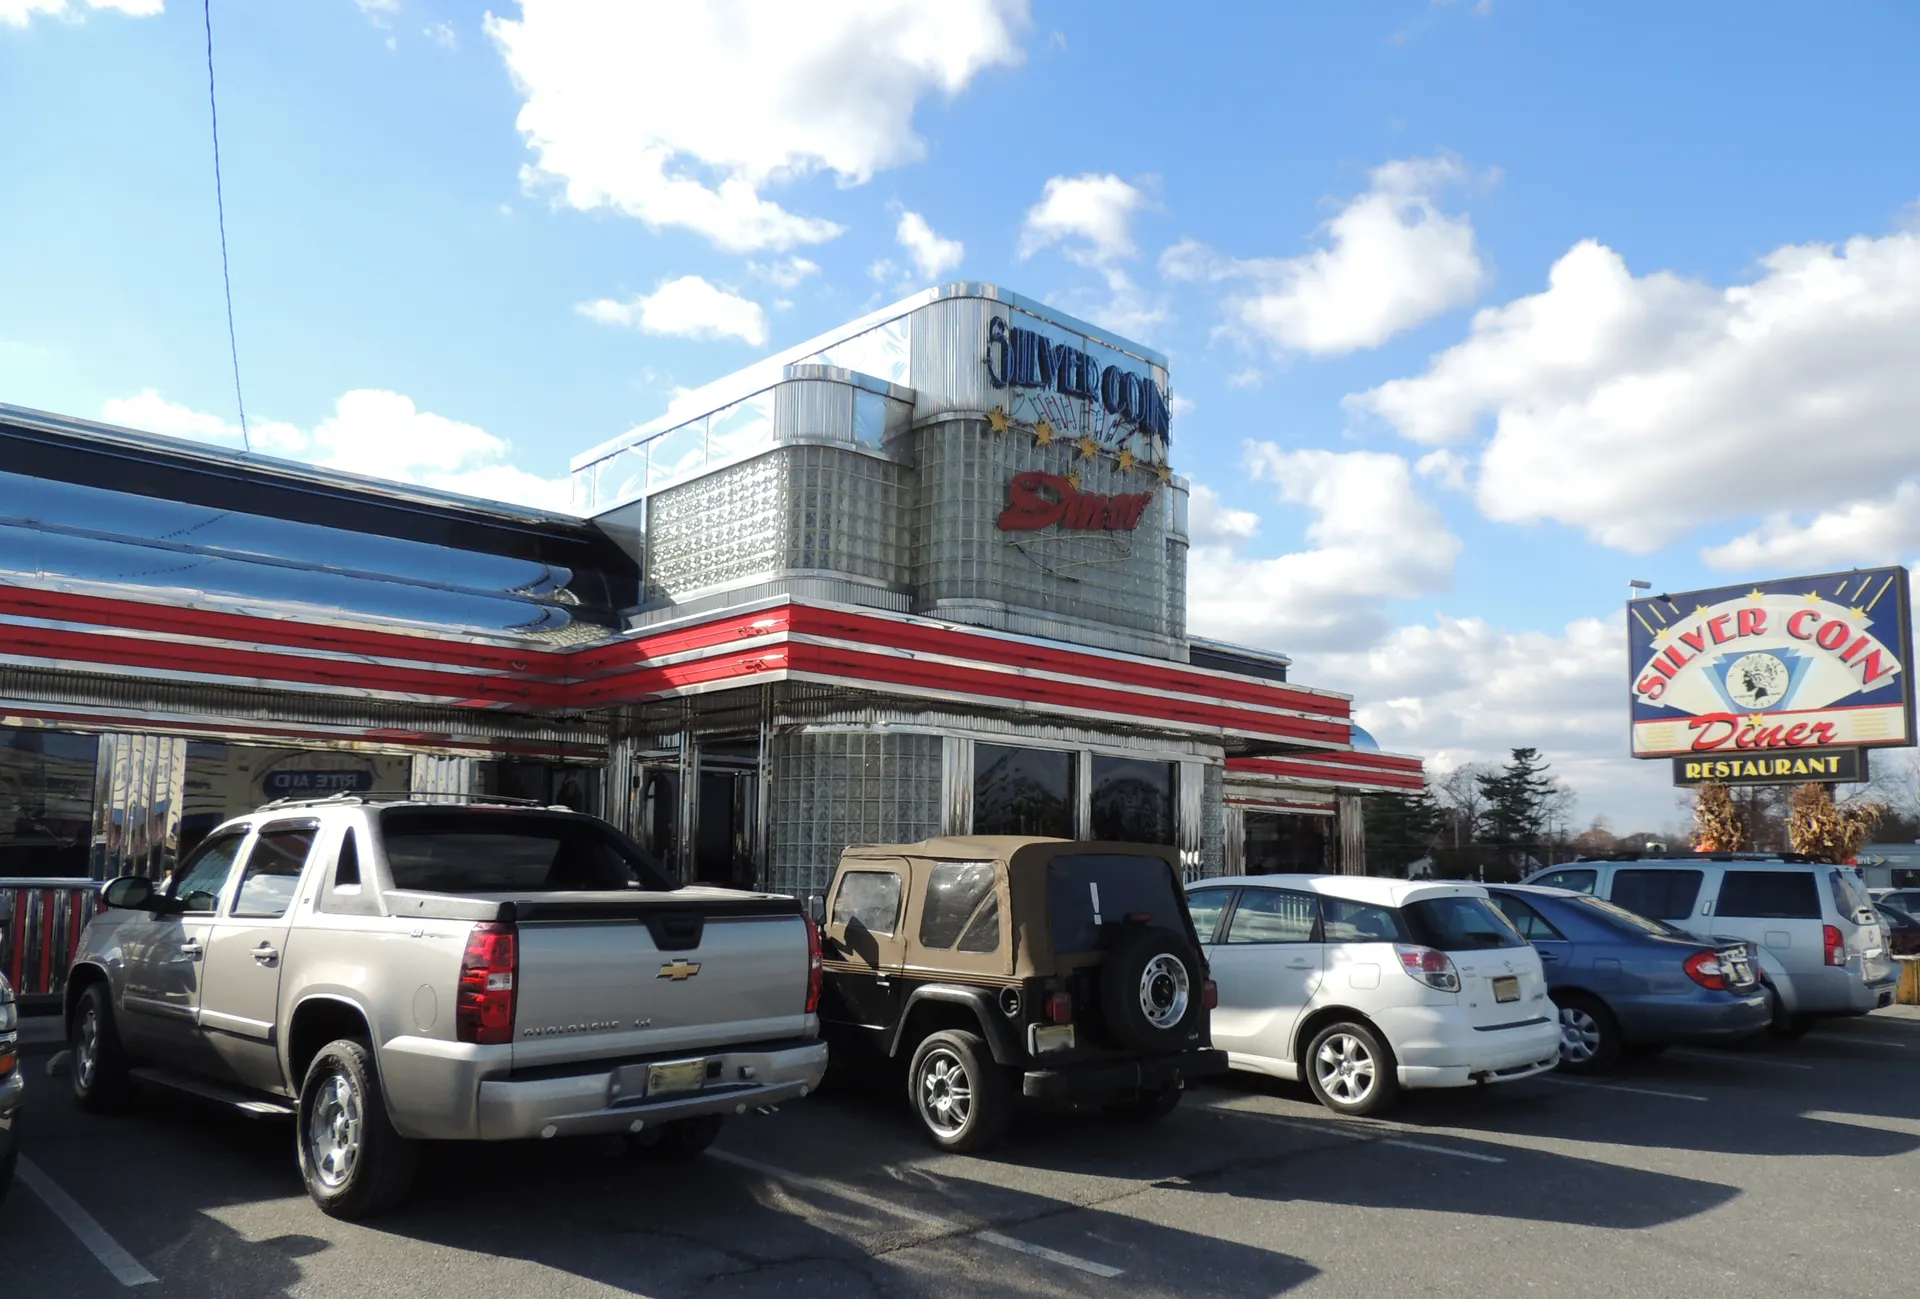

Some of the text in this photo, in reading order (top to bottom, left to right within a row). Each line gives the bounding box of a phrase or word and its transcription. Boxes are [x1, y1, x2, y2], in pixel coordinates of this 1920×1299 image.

[987, 316, 1171, 446] SILVER COIN
[1637, 607, 1895, 700] SILVER COIN
[1688, 712, 1838, 751] Diner
[1685, 756, 1841, 779] RESTAURANT
[523, 1020, 620, 1037] AVALANCHE
